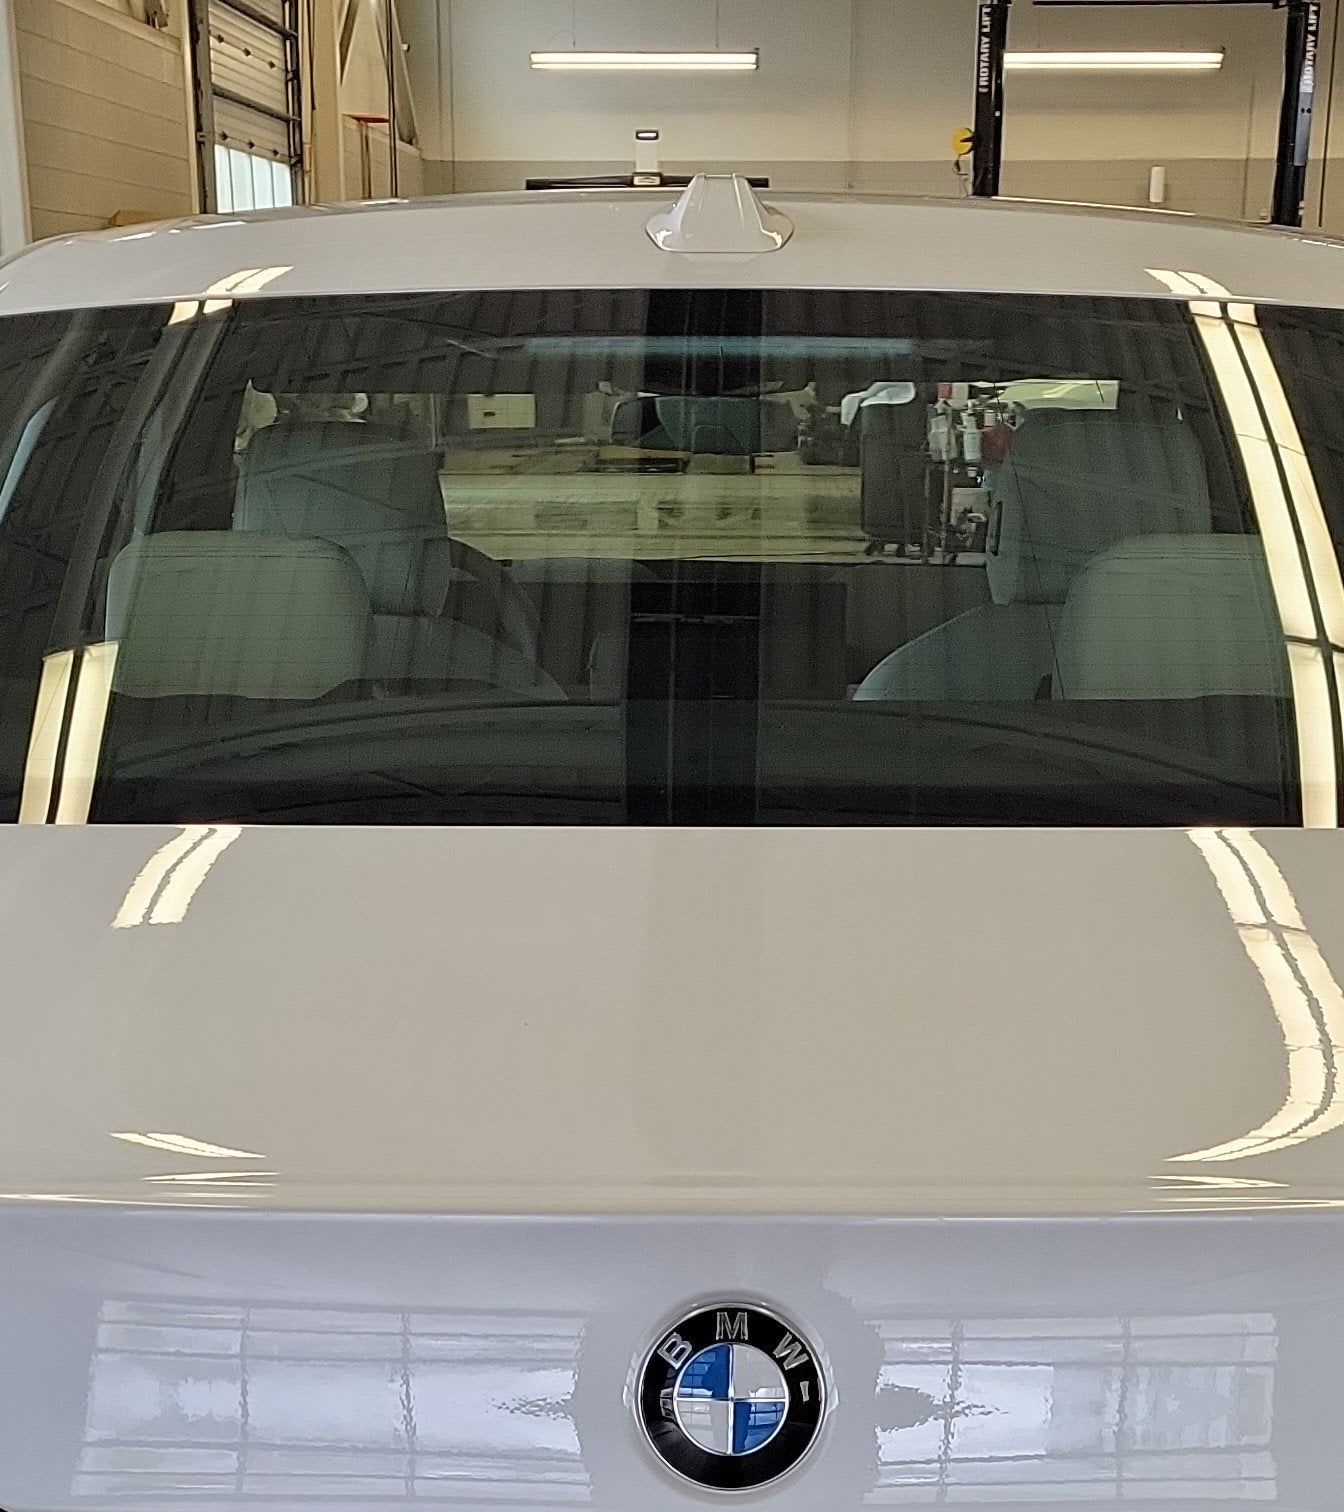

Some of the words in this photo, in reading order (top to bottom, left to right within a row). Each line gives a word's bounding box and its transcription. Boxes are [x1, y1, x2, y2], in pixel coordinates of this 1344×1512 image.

[981, 7, 992, 33] LIFT
[1307, 4, 1319, 31] LIFT
[979, 36, 991, 86] ROTARY
[657, 1311, 808, 1371] BMW
